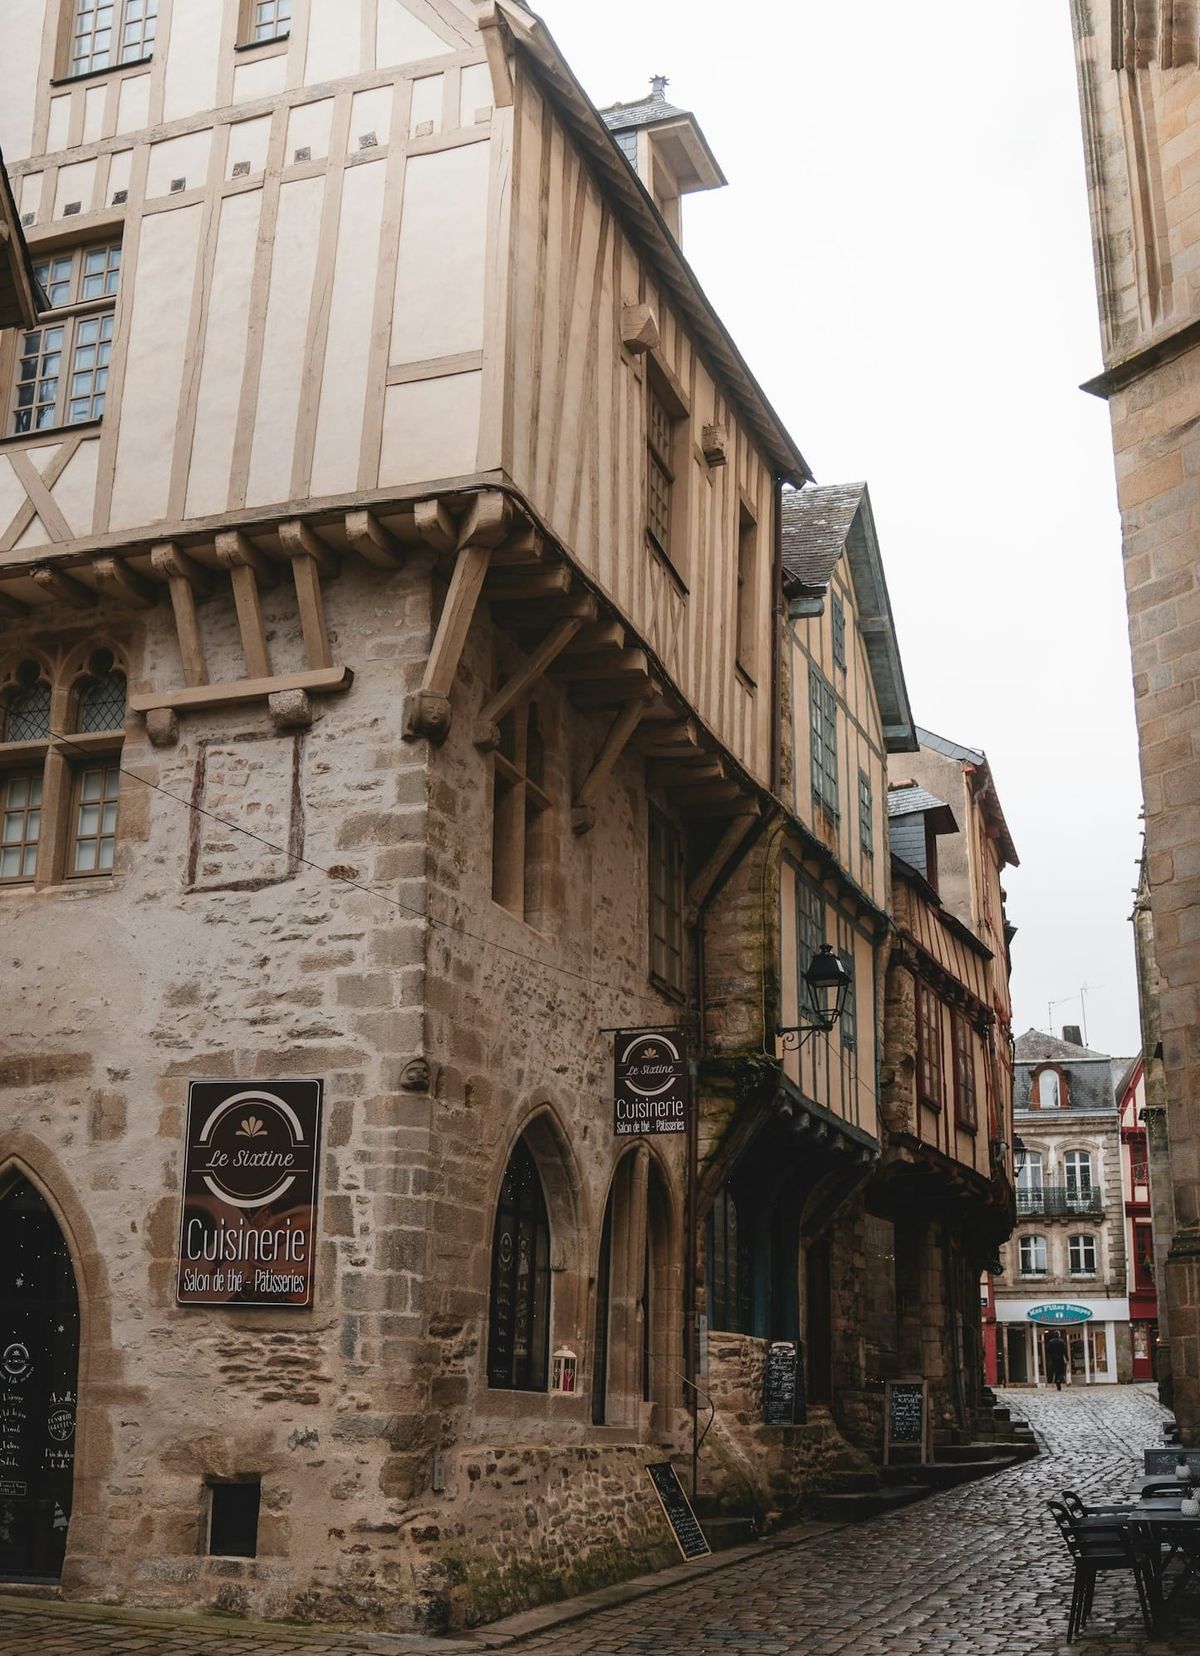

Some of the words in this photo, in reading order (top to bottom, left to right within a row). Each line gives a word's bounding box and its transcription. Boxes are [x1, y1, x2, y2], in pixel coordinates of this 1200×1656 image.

[626, 1066, 639, 1076] Le
[640, 1065, 674, 1075] Sixtine
[617, 1096, 684, 1119] Cuisinerie
[616, 1121, 632, 1134] Salon
[633, 1121, 640, 1133] de
[641, 1119, 650, 1133] thé
[656, 1119, 685, 1132] Pâtisseries
[206, 1149, 229, 1167] Le
[232, 1149, 295, 1167] Sixtine
[187, 1217, 305, 1262] Cuisinerie
[184, 1267, 210, 1292] Salon
[213, 1268, 224, 1292] de
[227, 1268, 243, 1293] thé
[254, 1269, 305, 1294] Pâtisseries
